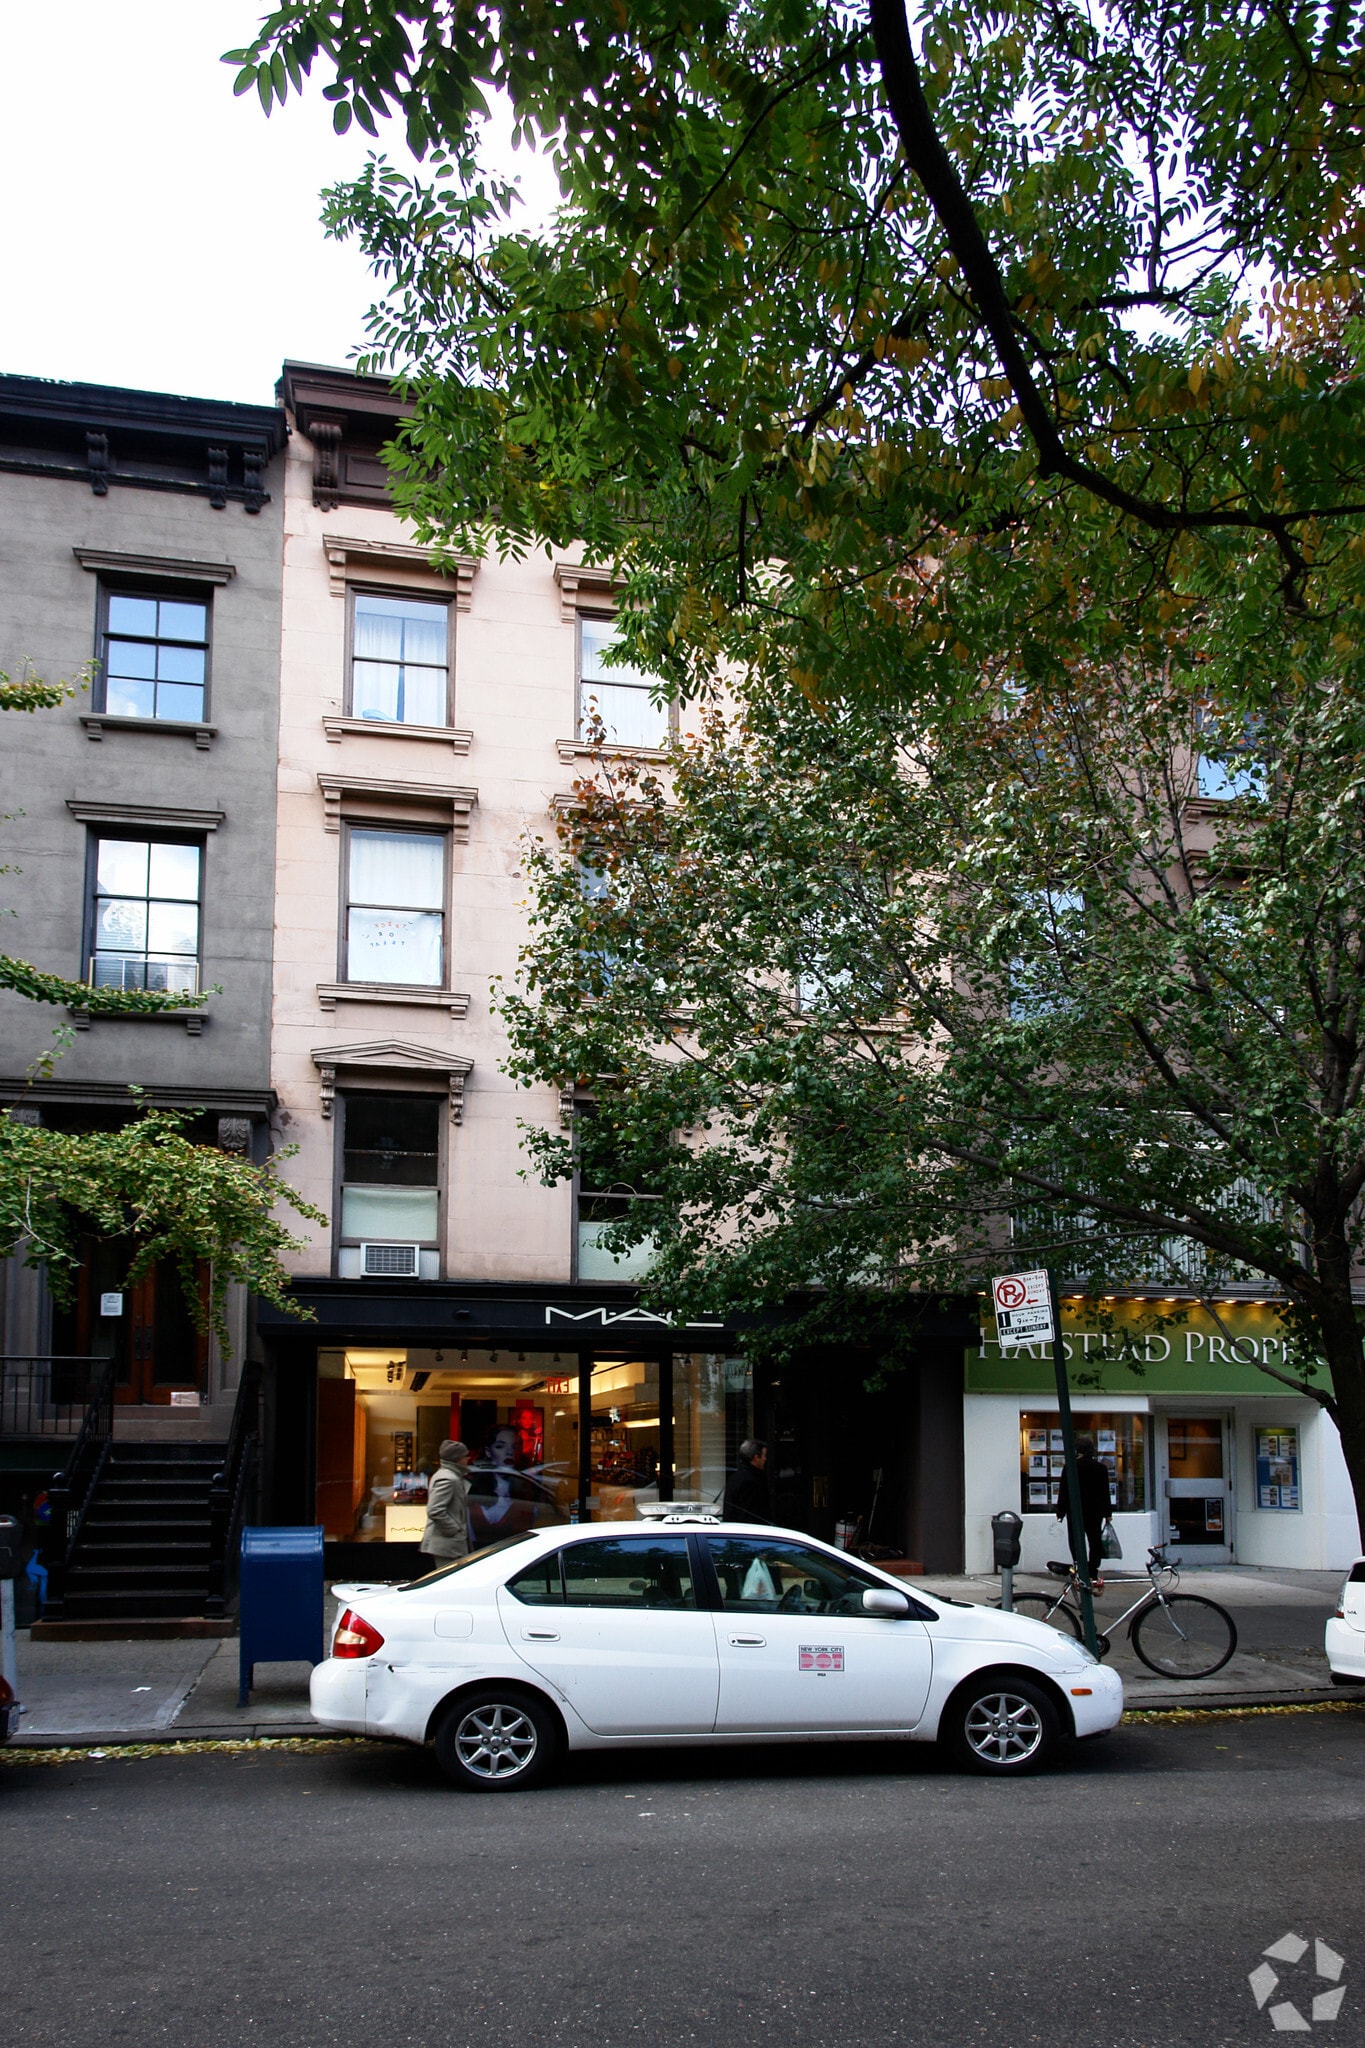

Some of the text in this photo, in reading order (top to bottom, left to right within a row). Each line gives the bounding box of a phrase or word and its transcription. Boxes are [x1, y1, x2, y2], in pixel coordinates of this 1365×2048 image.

[1002, 1323, 1047, 1336] EXCEPT SUNDAY
[1184, 1331, 1329, 1366] PROPE
[801, 1653, 843, 1669] DOT
